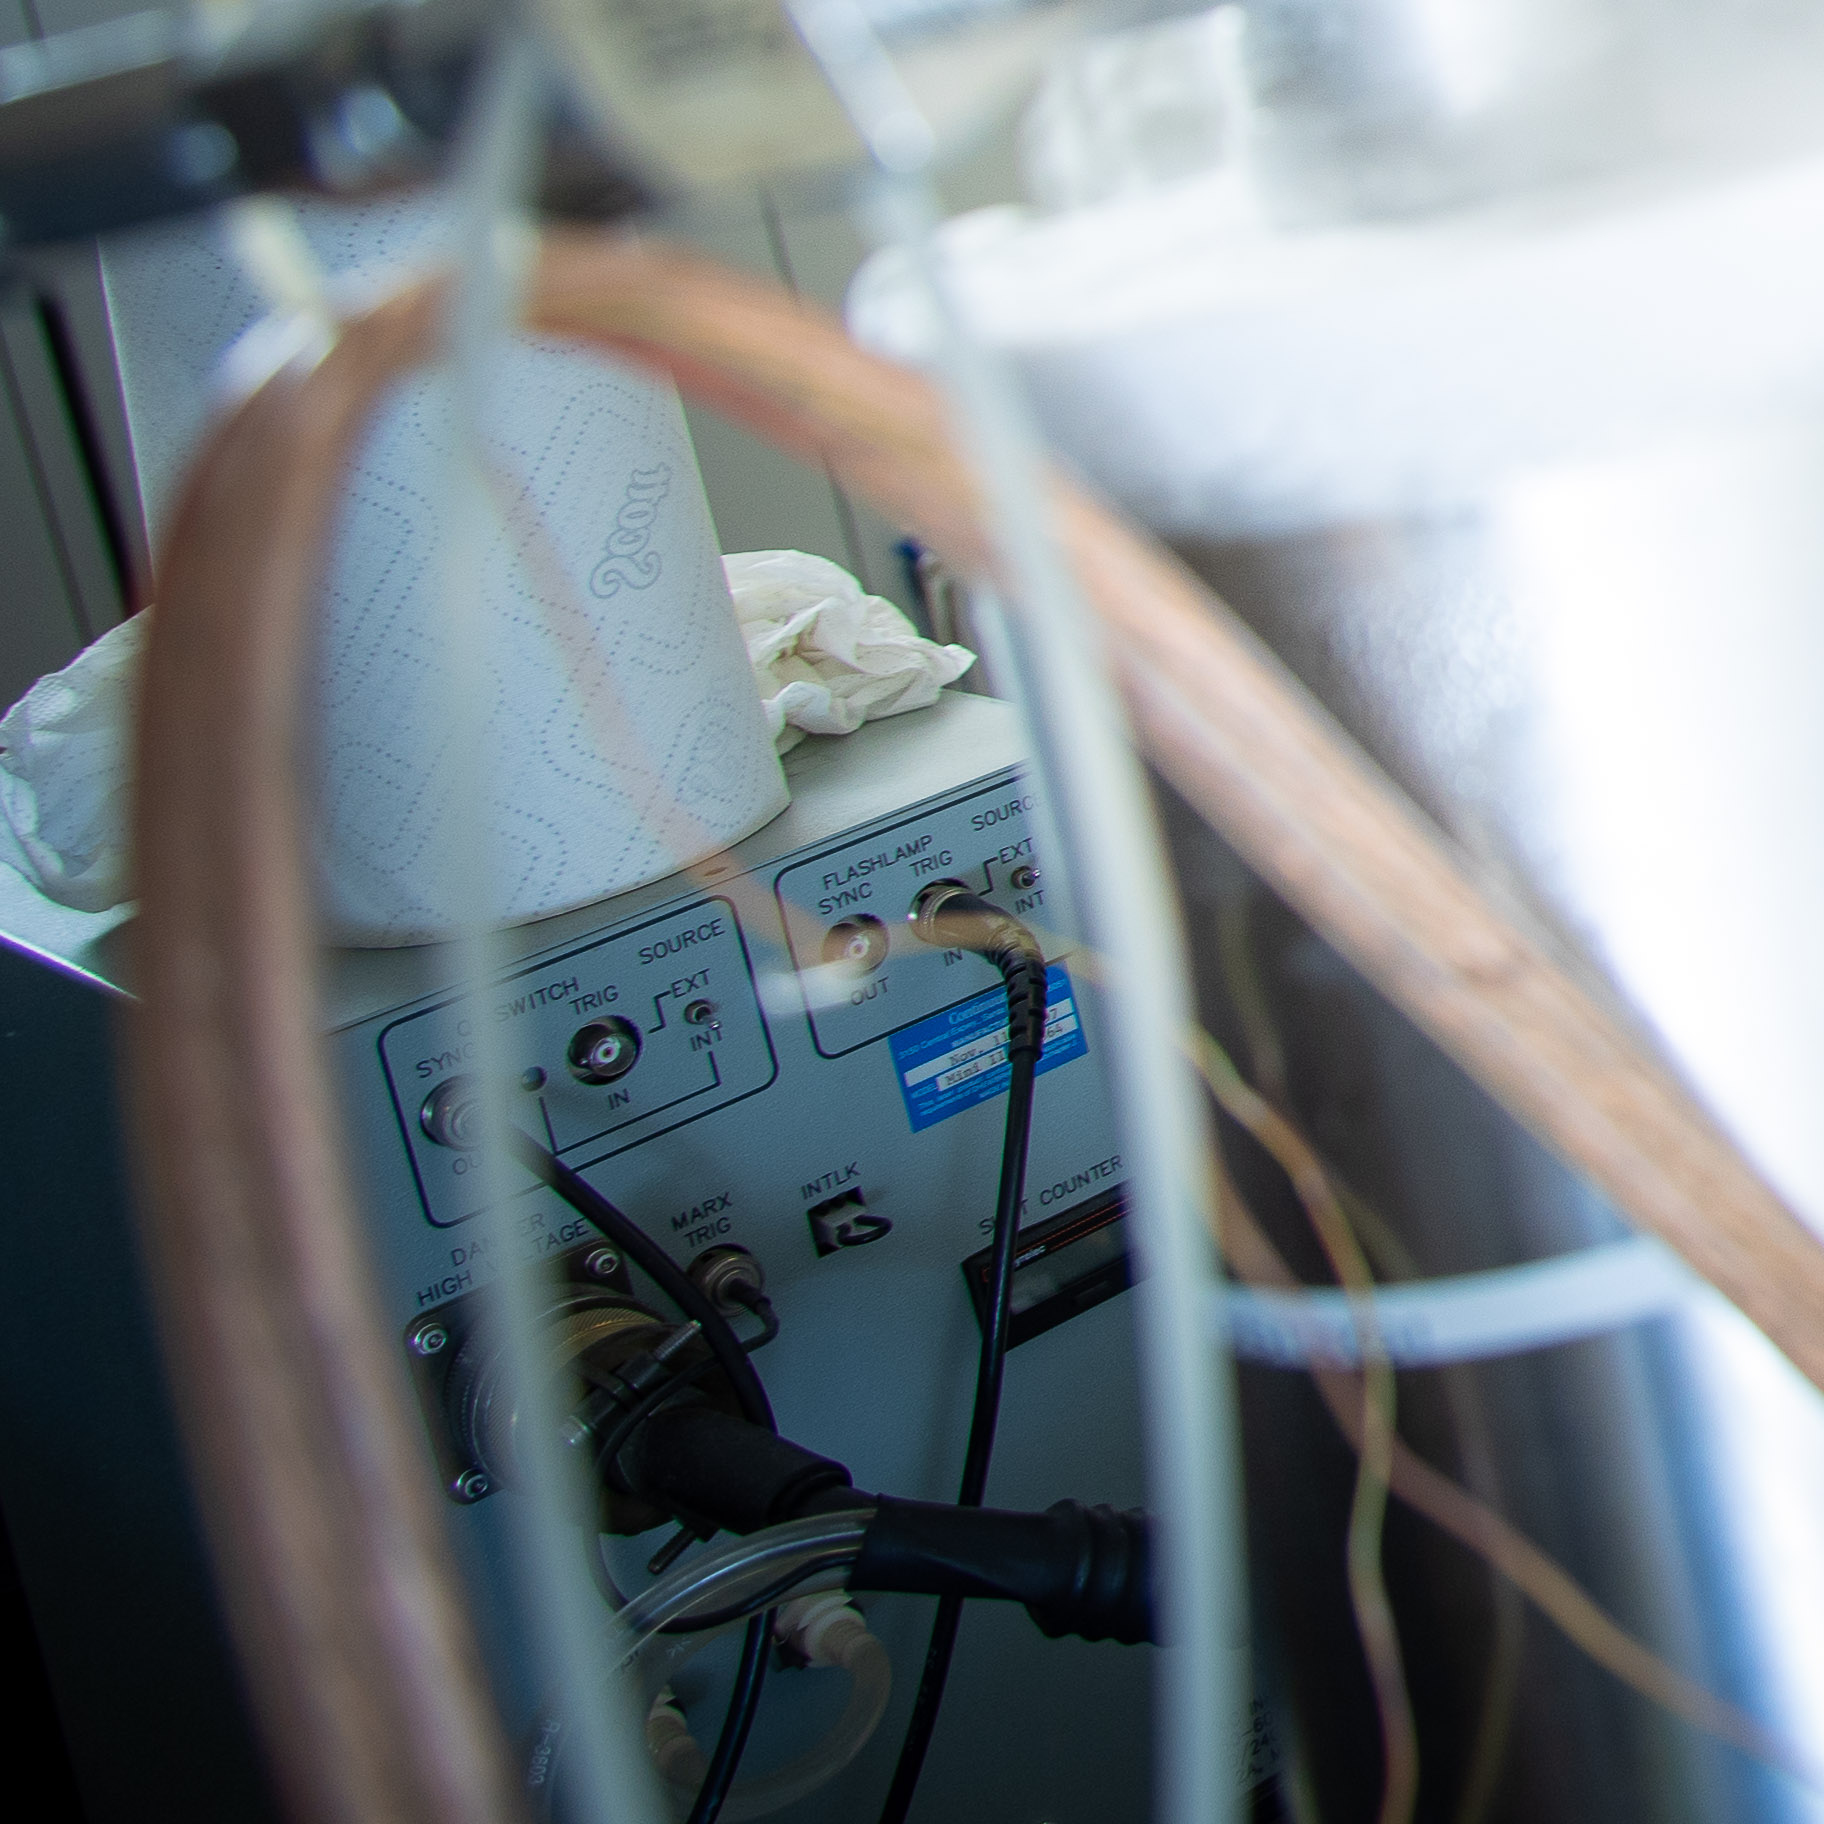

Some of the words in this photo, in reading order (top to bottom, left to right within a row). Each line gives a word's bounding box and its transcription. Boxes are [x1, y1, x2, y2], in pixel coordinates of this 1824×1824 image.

[970, 795, 1037, 831] SOURC
[822, 835, 933, 890] FLASHLAMP
[999, 837, 1034, 865] EXT
[818, 882, 873, 915] SYNC
[908, 850, 952, 877] TRIG
[1014, 889, 1045, 915] INT
[638, 918, 726, 965] SOURCE
[943, 947, 964, 967] IN
[671, 968, 711, 998] EXT
[852, 977, 889, 1006] OUT
[569, 985, 620, 1015] TRIG
[689, 1029, 724, 1052] INT
[948, 1042, 984, 1067] Nov.
[944, 1061, 980, 1086] Mini
[607, 1089, 630, 1110] IN
[452, 1153, 483, 1175] OU
[800, 1161, 861, 1200] INTLK
[1040, 1154, 1124, 1206] COUNTER
[671, 1192, 733, 1231] MARX
[684, 1216, 731, 1248] TRIG
[416, 1270, 473, 1306] HIGH
